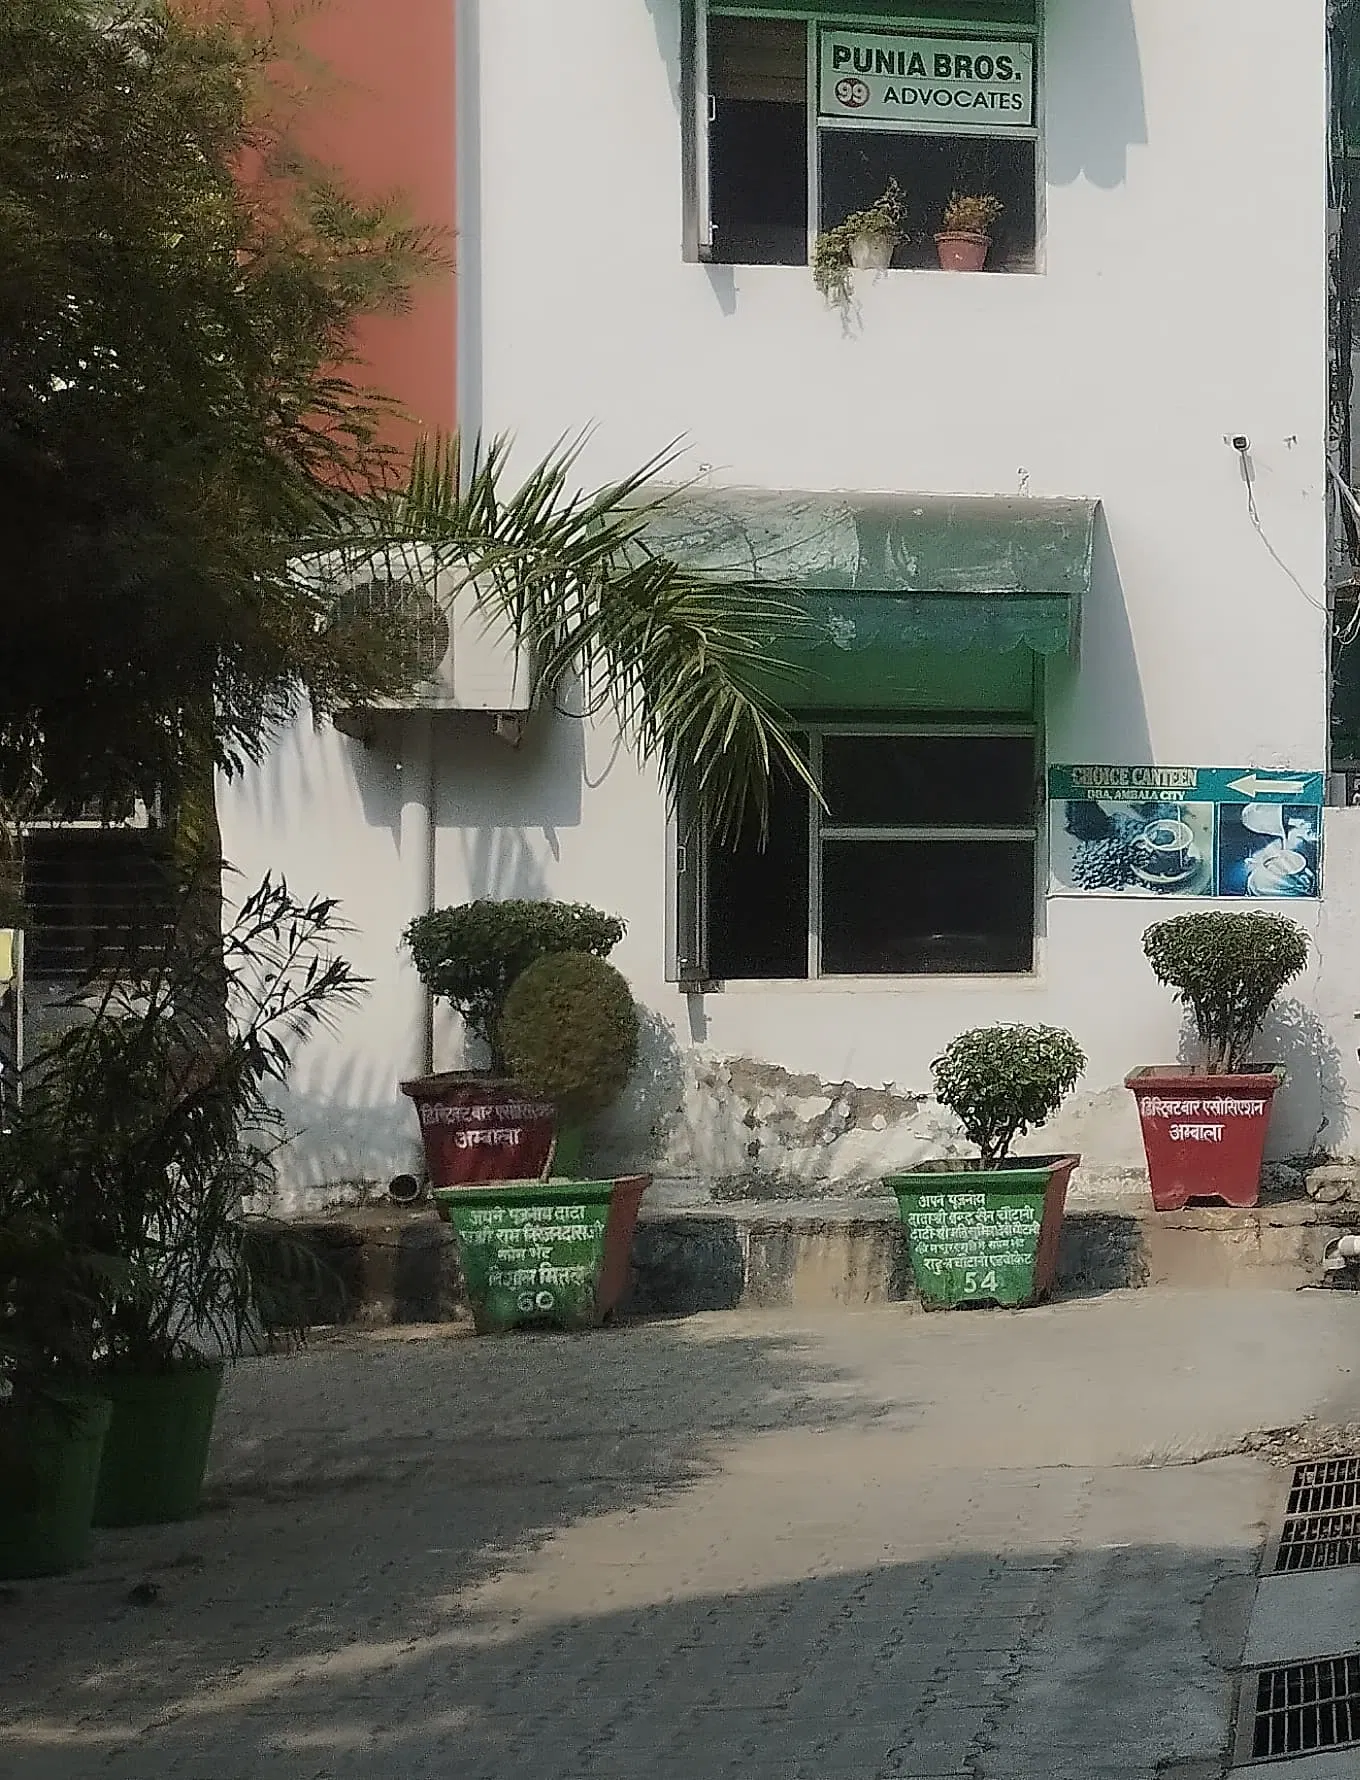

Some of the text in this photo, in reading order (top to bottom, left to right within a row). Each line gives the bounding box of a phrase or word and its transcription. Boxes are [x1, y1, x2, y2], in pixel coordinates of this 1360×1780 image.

[832, 44, 1022, 81] PUNIA BROS.
[883, 86, 1023, 111] ADVOCATES
[1072, 766, 1197, 787] CHOICE CANTEEN
[1159, 790, 1185, 801] CITY
[1170, 1124, 1225, 1143] अम्बाला
[963, 1269, 999, 1294] 54
